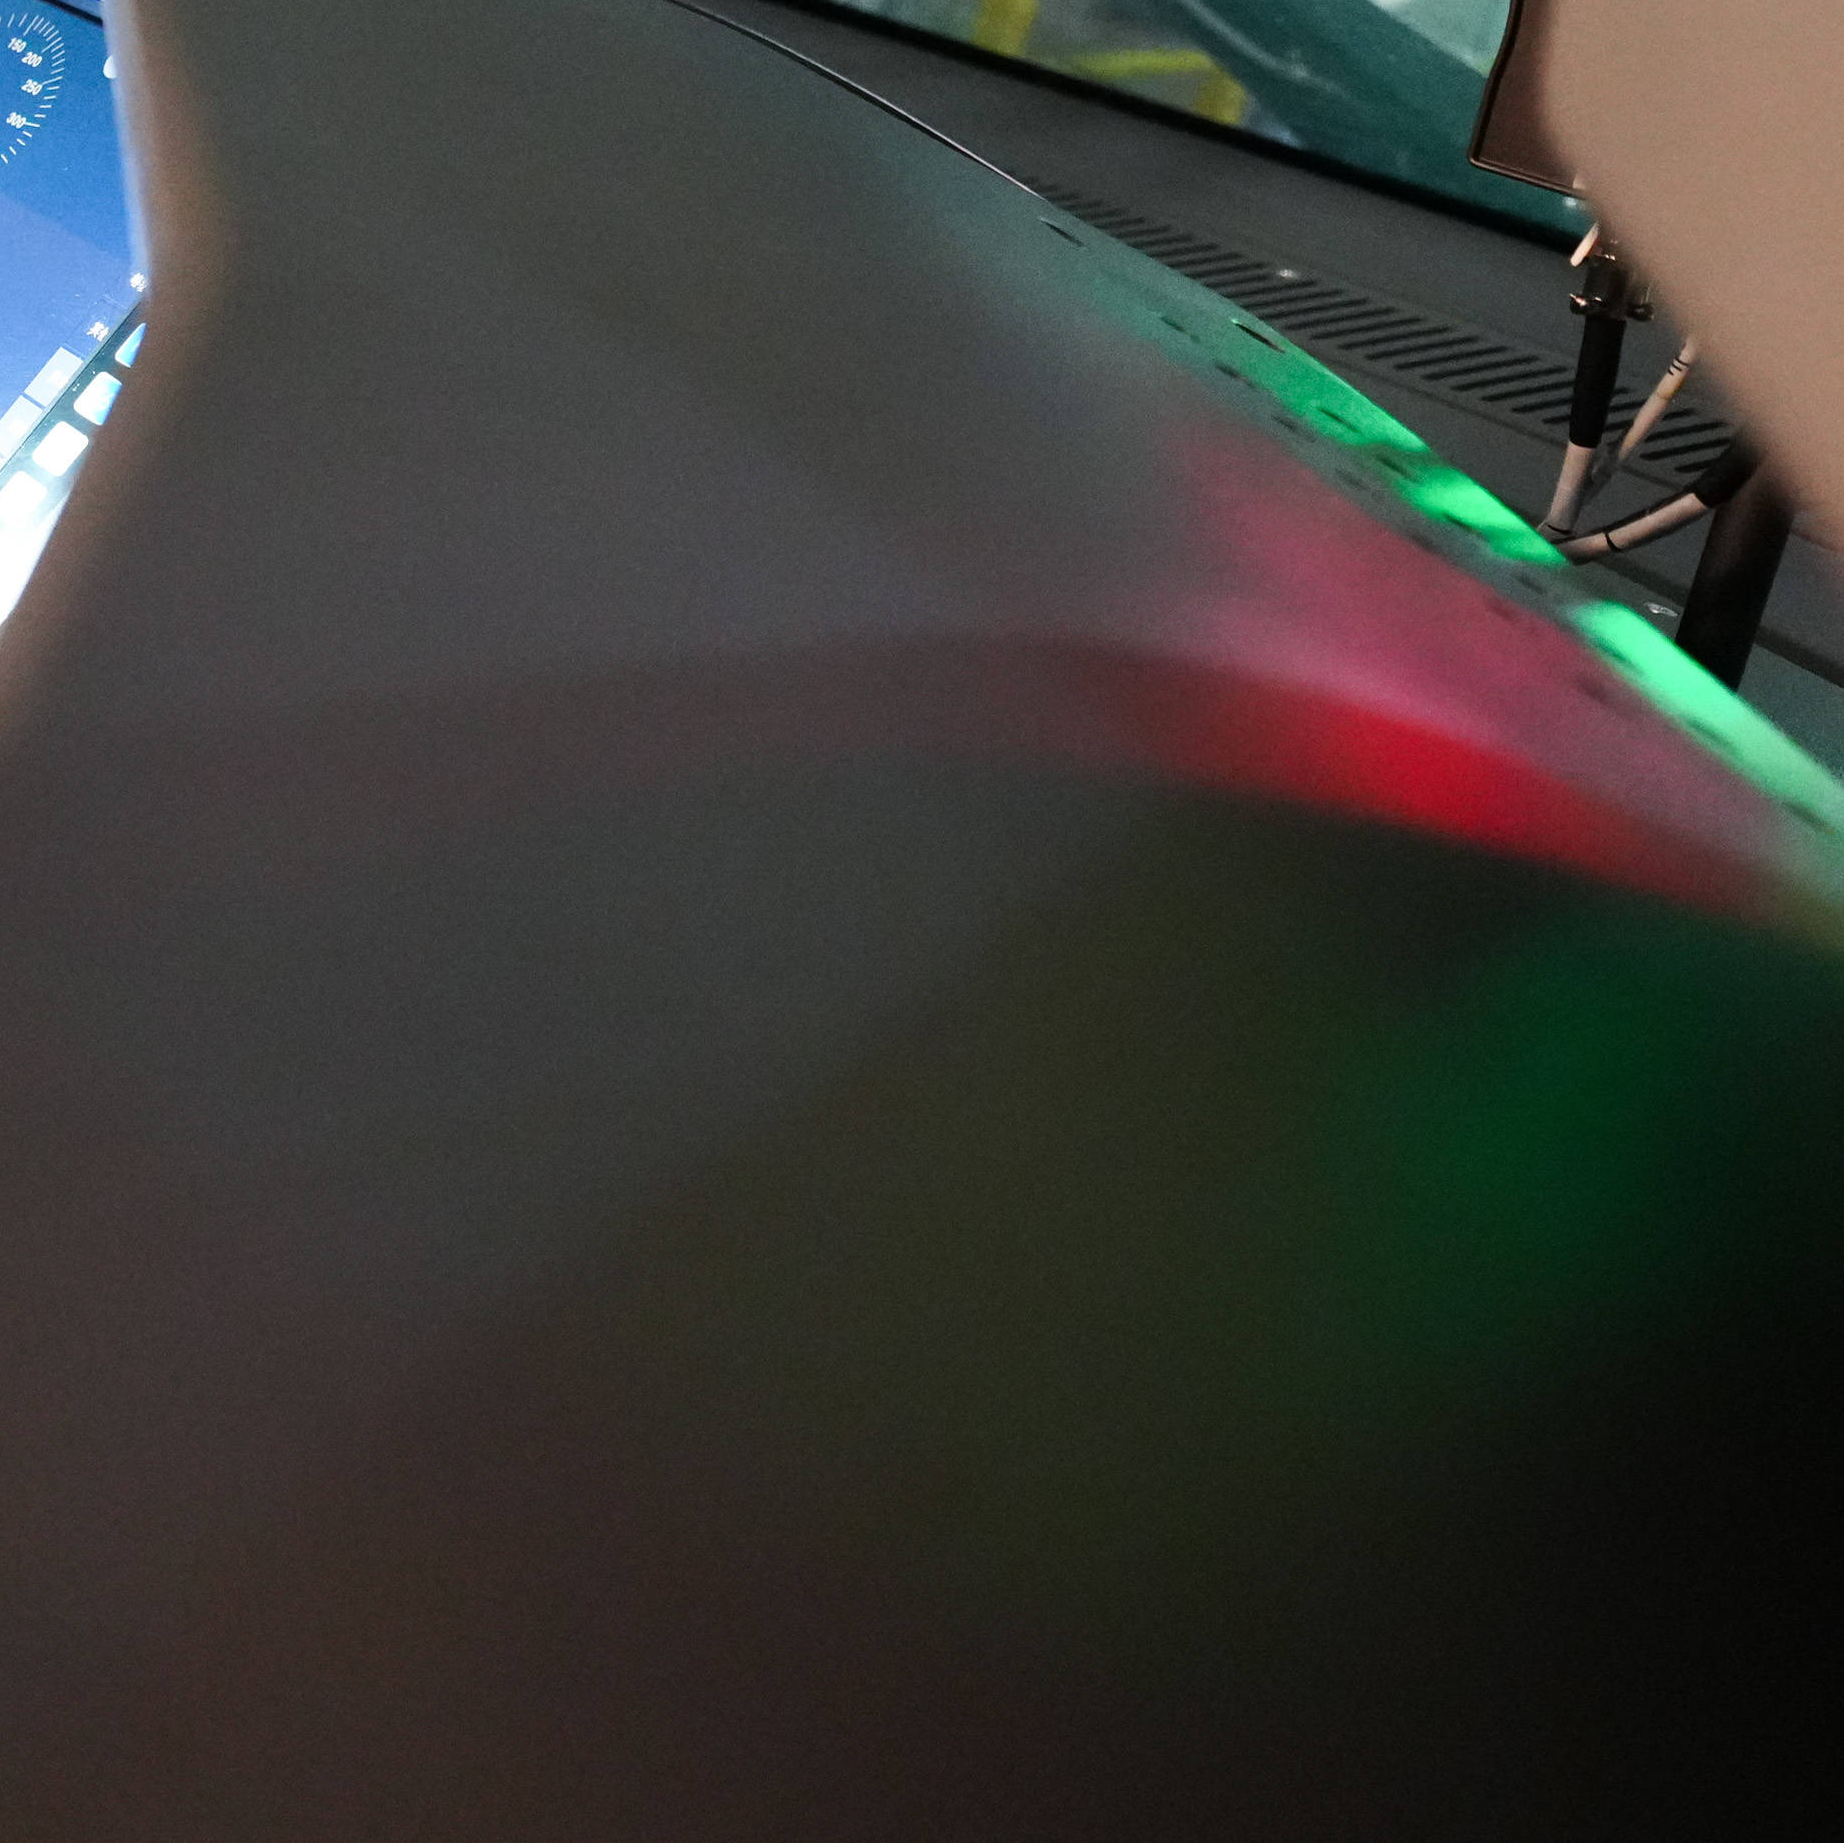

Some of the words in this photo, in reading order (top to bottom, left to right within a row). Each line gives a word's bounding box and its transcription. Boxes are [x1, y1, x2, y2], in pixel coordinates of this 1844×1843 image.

[7, 37, 27, 53] 150
[21, 51, 43, 68] 200
[21, 79, 43, 96] 250
[6, 112, 26, 129] 300
